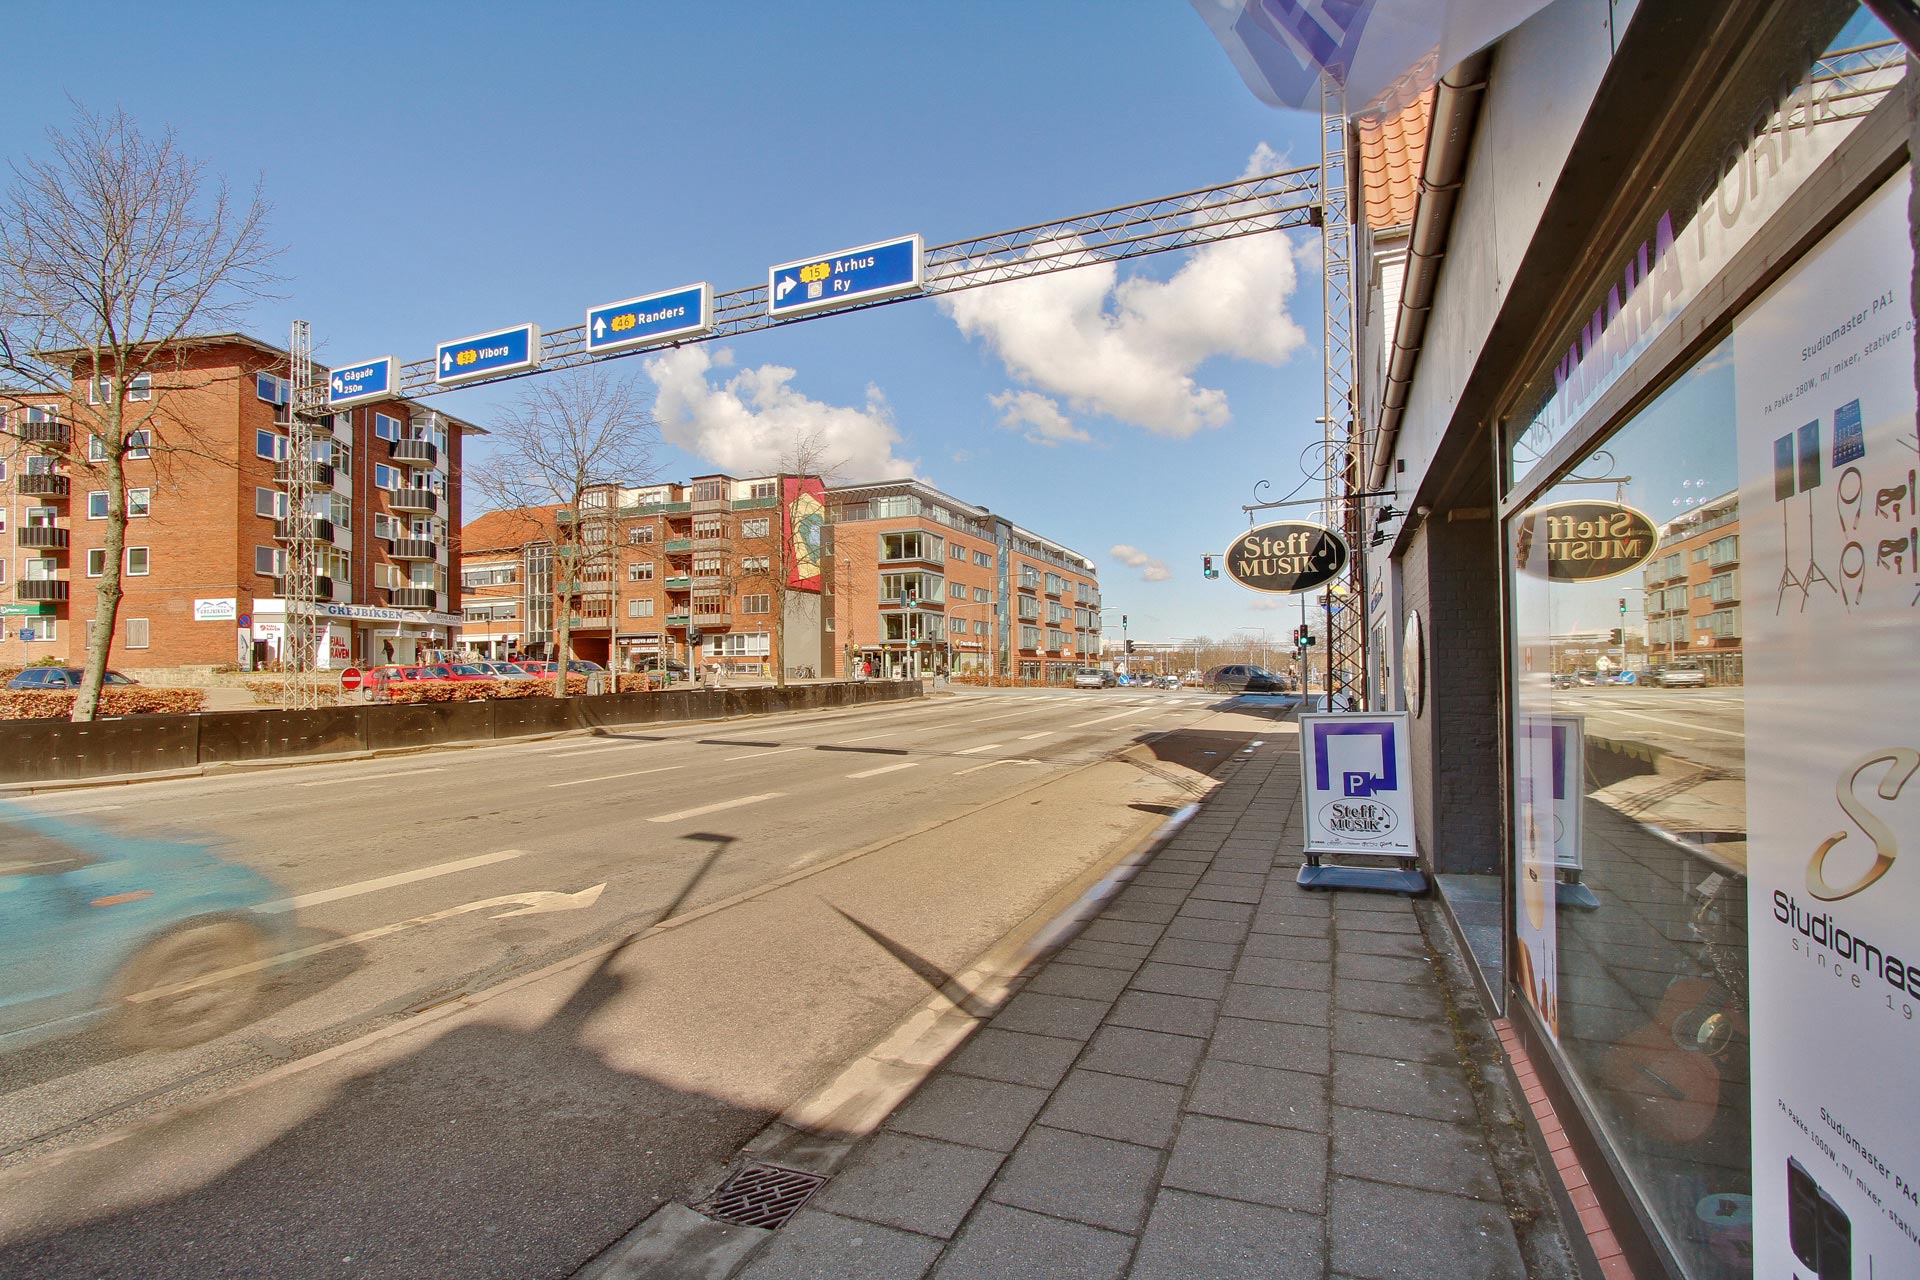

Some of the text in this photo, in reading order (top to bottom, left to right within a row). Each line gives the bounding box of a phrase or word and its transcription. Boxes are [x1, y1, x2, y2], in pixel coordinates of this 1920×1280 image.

[808, 257, 874, 278] 15 Århus
[834, 280, 851, 291] Ry
[617, 306, 686, 327] 46 Randers
[1554, 207, 1684, 425] YAMAHA
[1801, 290, 1894, 362] Studiomaster PA1
[462, 346, 509, 362] 52 Viborg
[344, 368, 374, 382] Gågade
[1764, 405, 1772, 416] PA
[1774, 394, 1793, 411] Pakke
[1796, 378, 1818, 398] 280W,
[1820, 367, 1831, 383] m/
[1834, 353, 1861, 374] mixer,
[1864, 325, 1902, 357] stativer
[1244, 532, 1309, 559] Steff
[1238, 555, 1319, 578] MUSIK
[328, 605, 403, 620] GREJBIKSEN
[1332, 803, 1377, 820] Steff
[1330, 817, 1391, 832] MUSIK
[1792, 938, 1861, 988] since
[1820, 1107, 1891, 1179] Studiomaster
[1778, 1098, 1787, 1113] PA
[1788, 1108, 1808, 1135] Pakke
[1811, 1131, 1840, 1168] 1000W,
[1842, 1162, 1853, 1181] m/
[1856, 1177, 1886, 1213] mixer,
